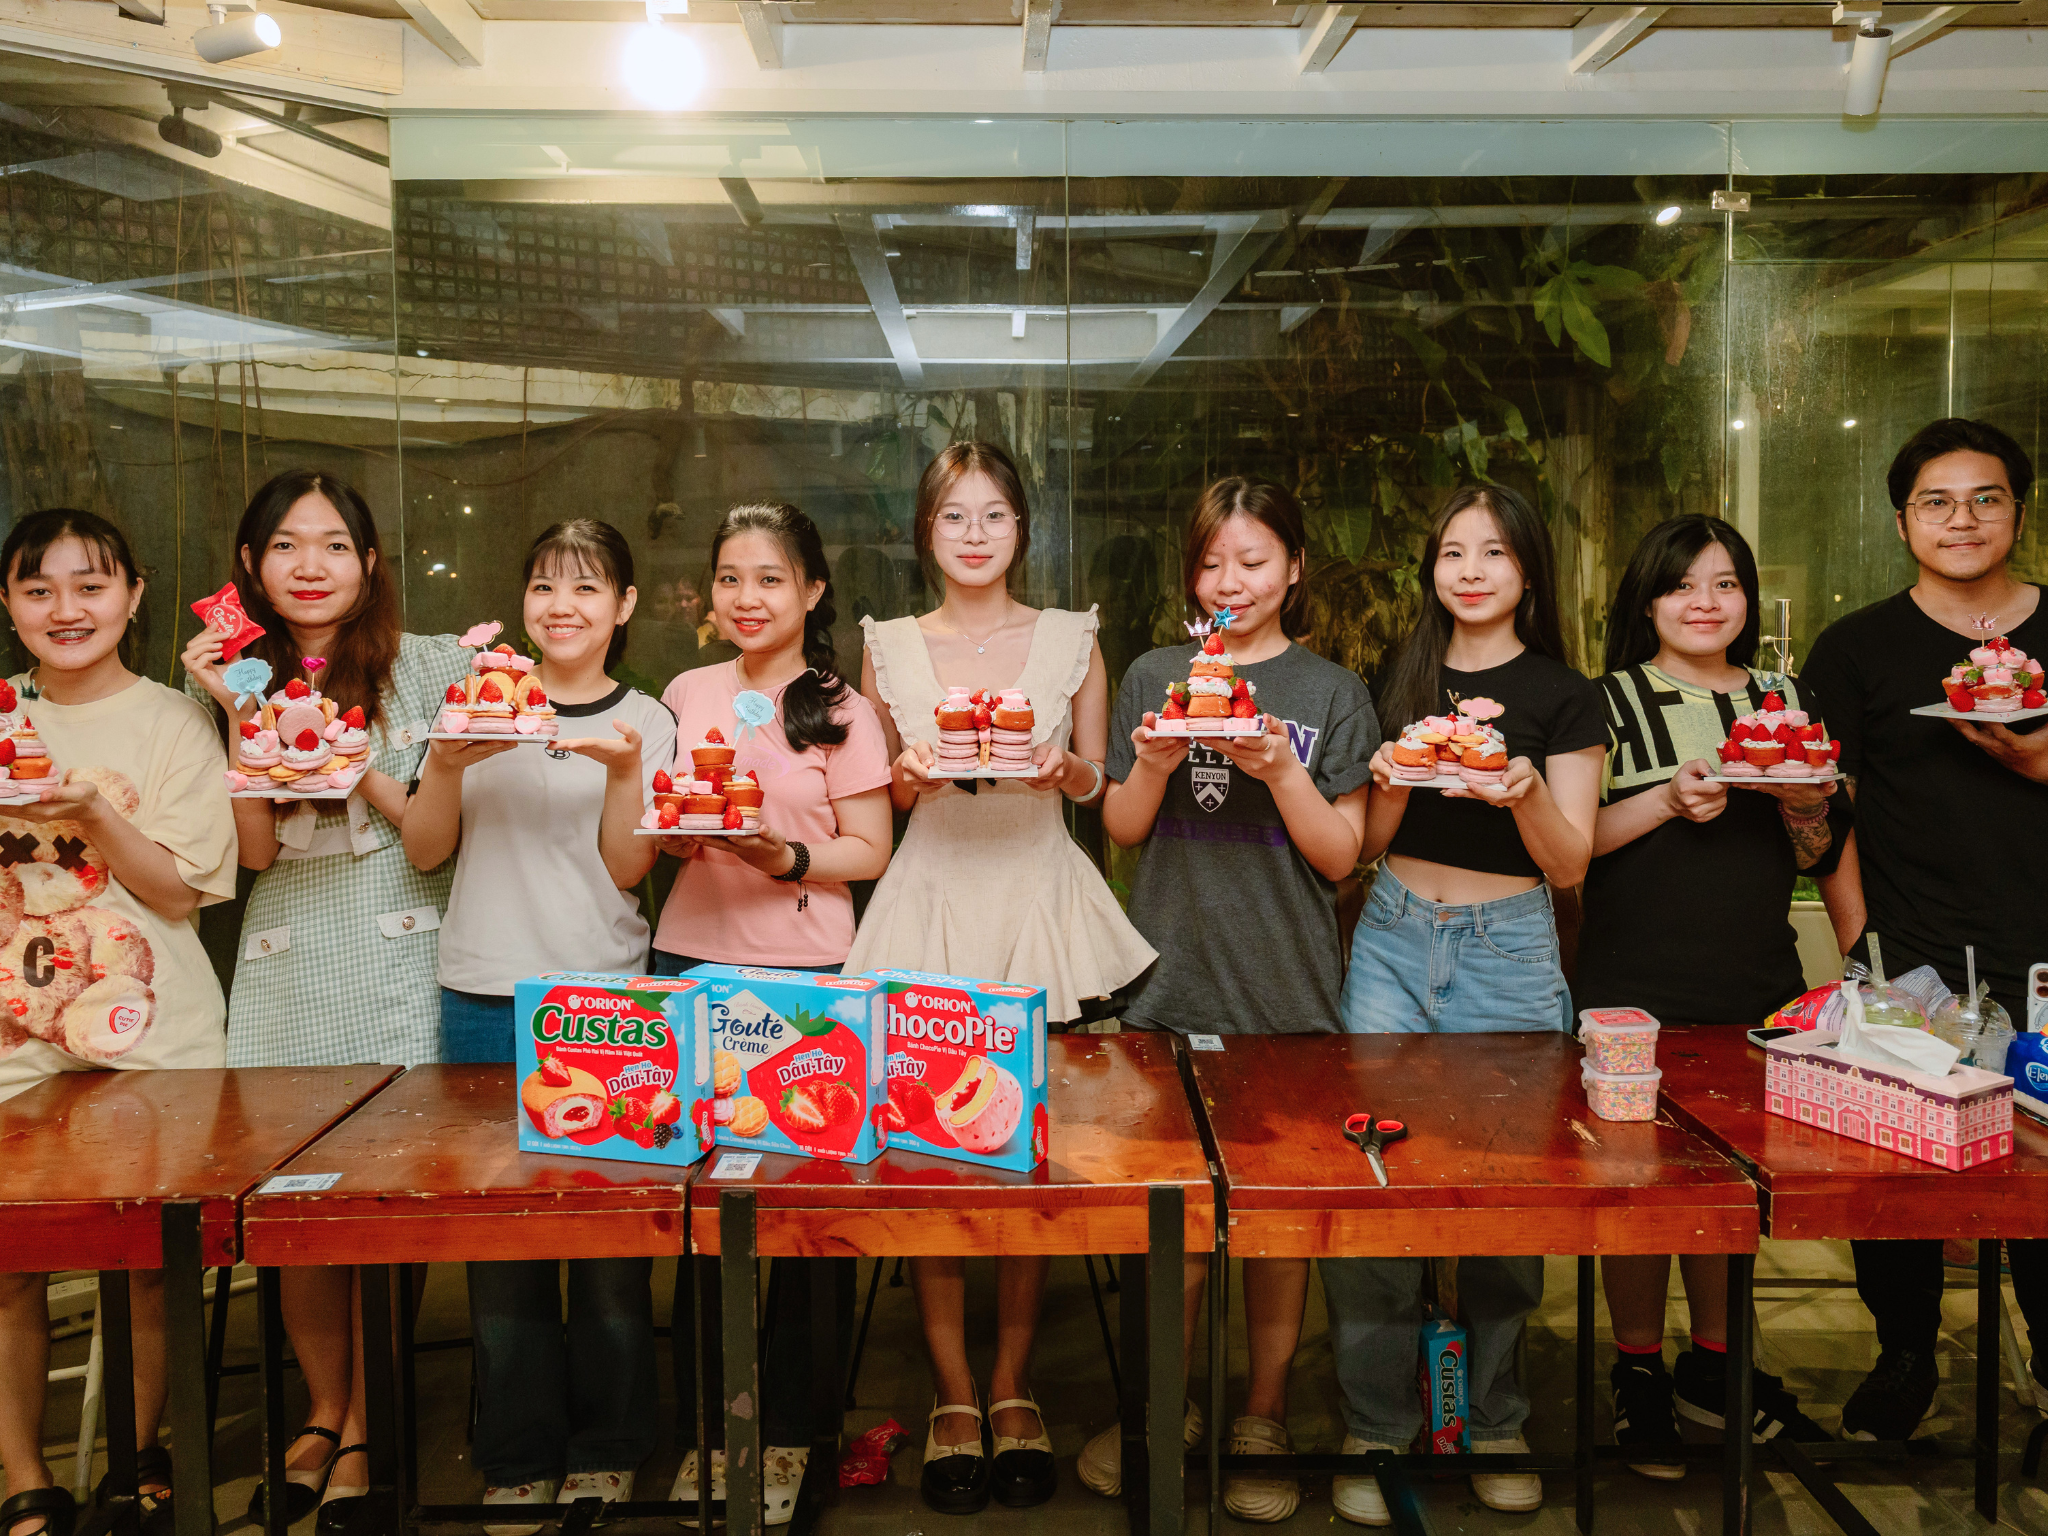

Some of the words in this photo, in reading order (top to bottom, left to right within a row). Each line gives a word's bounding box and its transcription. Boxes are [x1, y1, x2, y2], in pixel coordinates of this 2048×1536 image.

[1194, 771, 1227, 781] KENYON
[23, 936, 56, 988] C
[711, 984, 729, 994] ION
[584, 996, 632, 1011] ORION
[921, 995, 971, 1014] ORION
[118, 1015, 135, 1023] CUTIE
[530, 1002, 669, 1050] Custas
[711, 1003, 784, 1039] Gouté
[887, 1003, 1014, 1052] hocoPie
[722, 1036, 770, 1055] Crème
[1439, 1348, 1459, 1428] Custas
